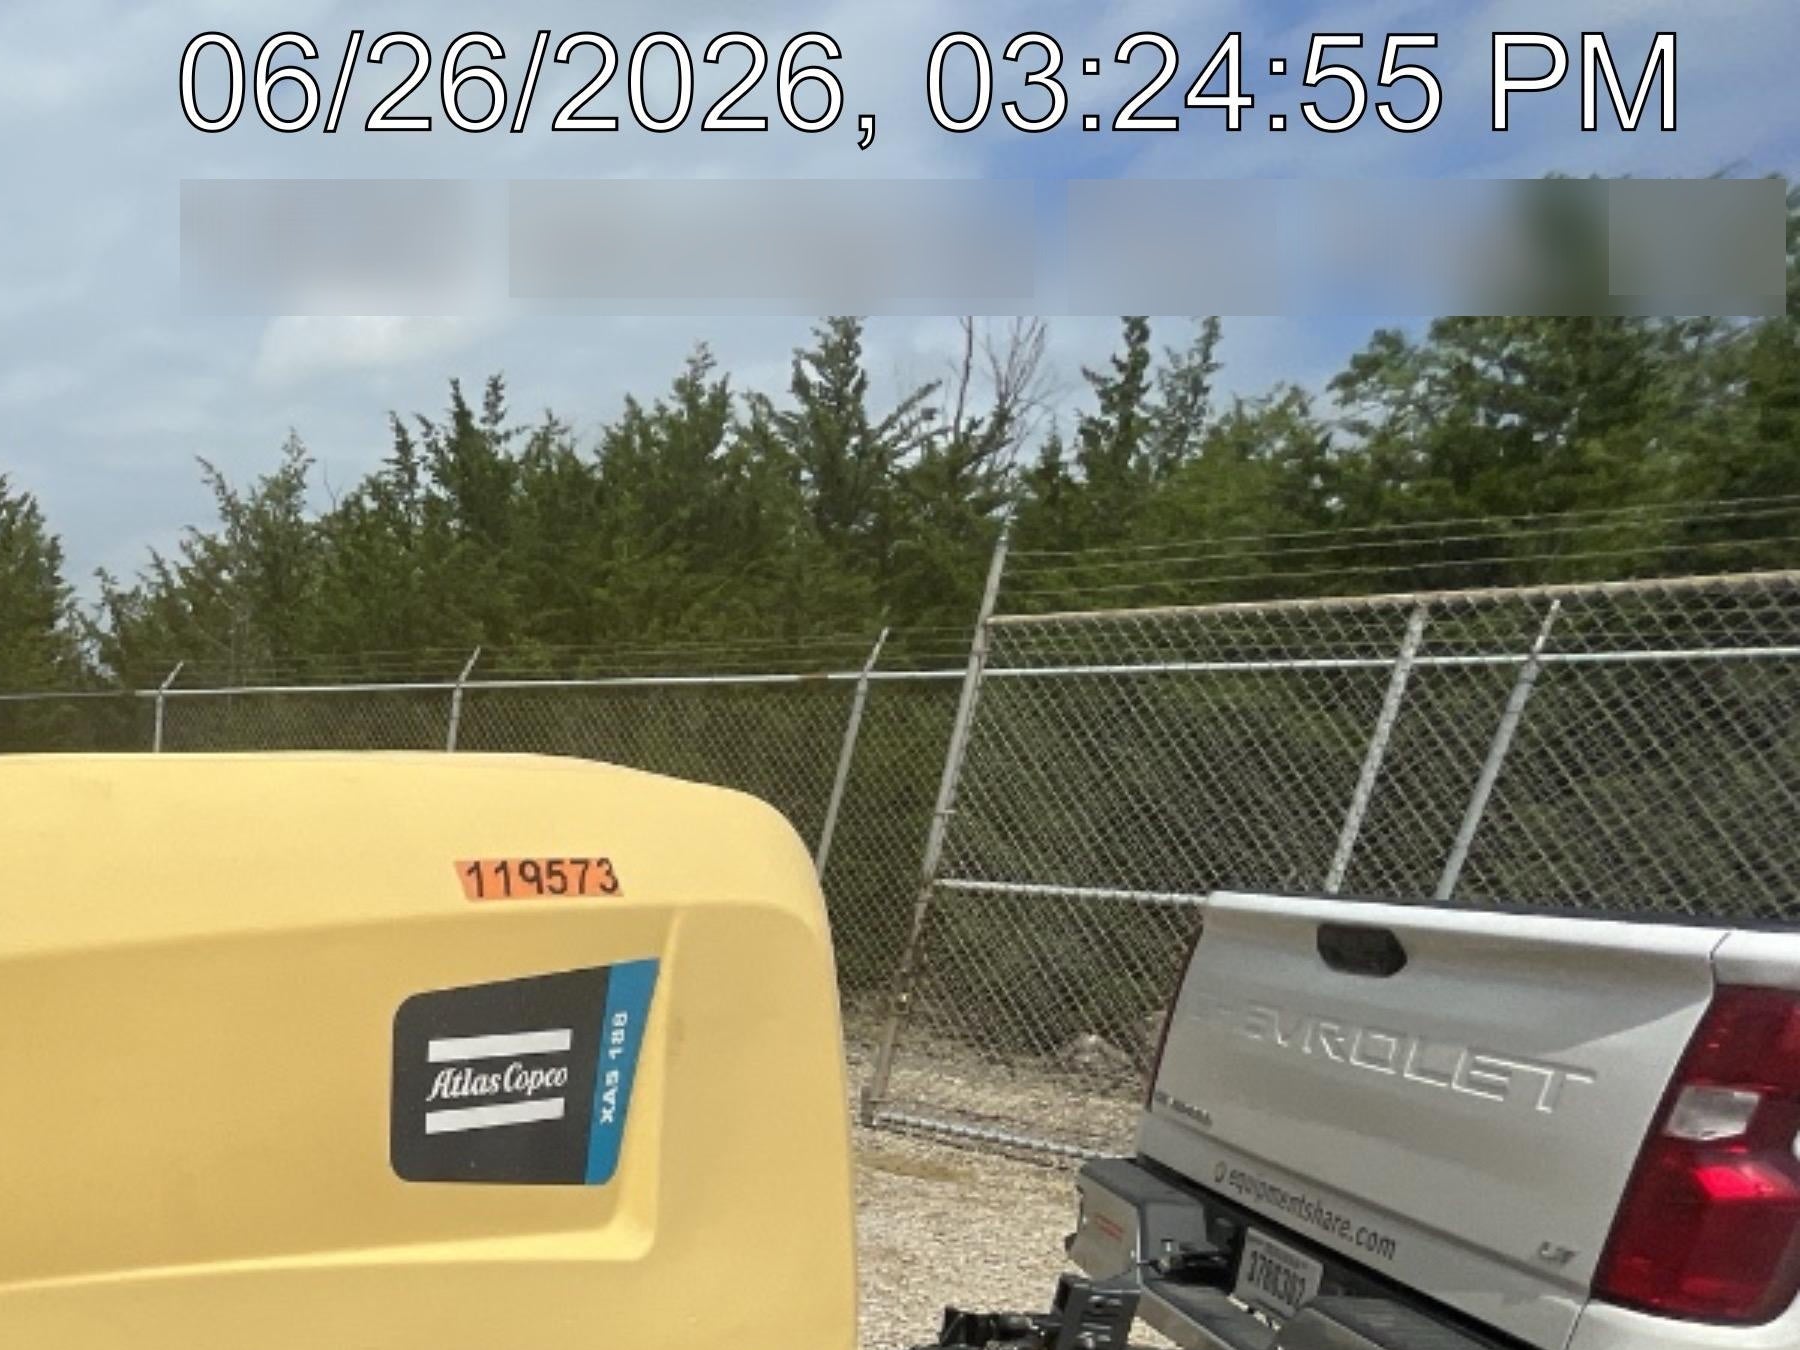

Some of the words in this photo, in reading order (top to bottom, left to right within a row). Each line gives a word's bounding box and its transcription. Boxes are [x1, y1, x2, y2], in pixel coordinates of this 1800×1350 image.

[466, 858, 620, 898] 119573
[426, 1065, 501, 1102] Atlas
[503, 1061, 569, 1096] Copco
[600, 1069, 619, 1125] XAS
